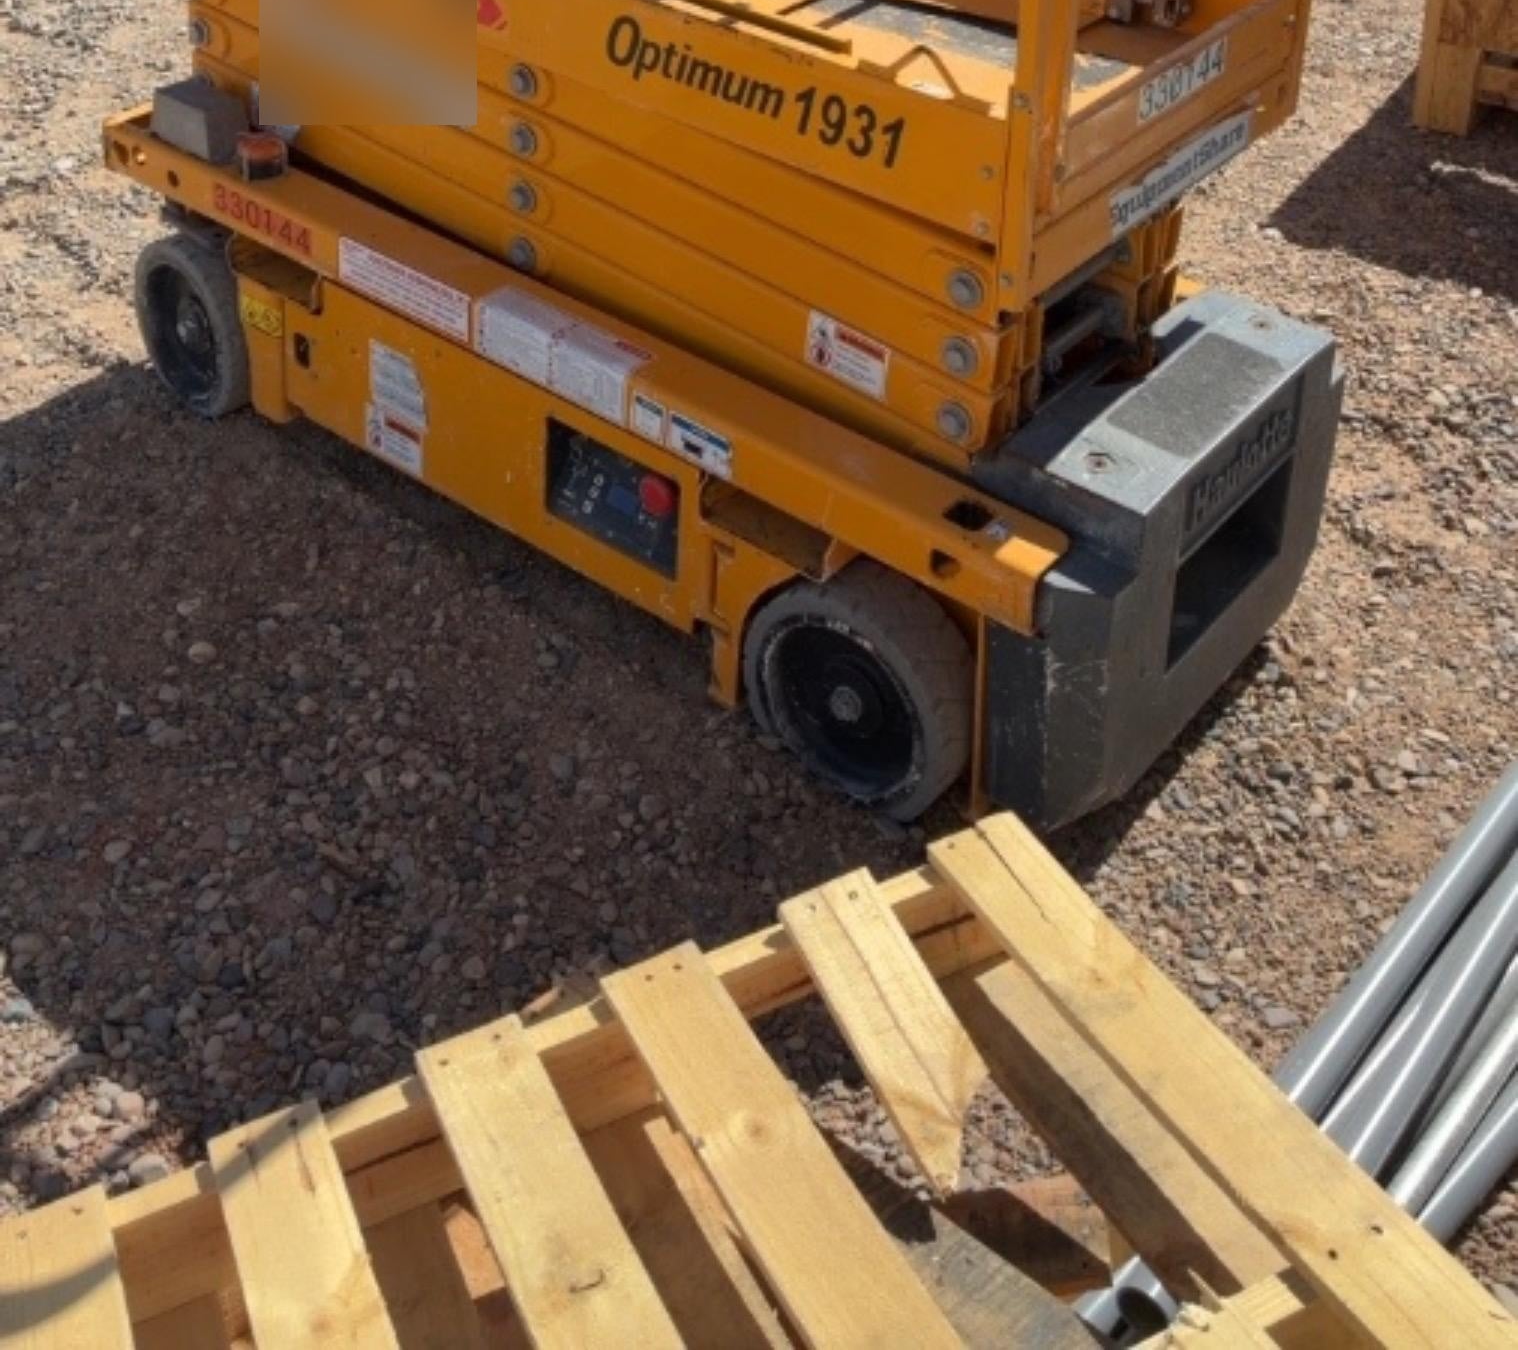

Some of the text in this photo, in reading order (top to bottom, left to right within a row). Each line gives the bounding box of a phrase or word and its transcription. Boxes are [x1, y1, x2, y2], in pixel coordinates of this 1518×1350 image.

[606, 14, 905, 169] Optimum 1931
[1139, 41, 1224, 118] 330144
[213, 181, 312, 258] 330144
